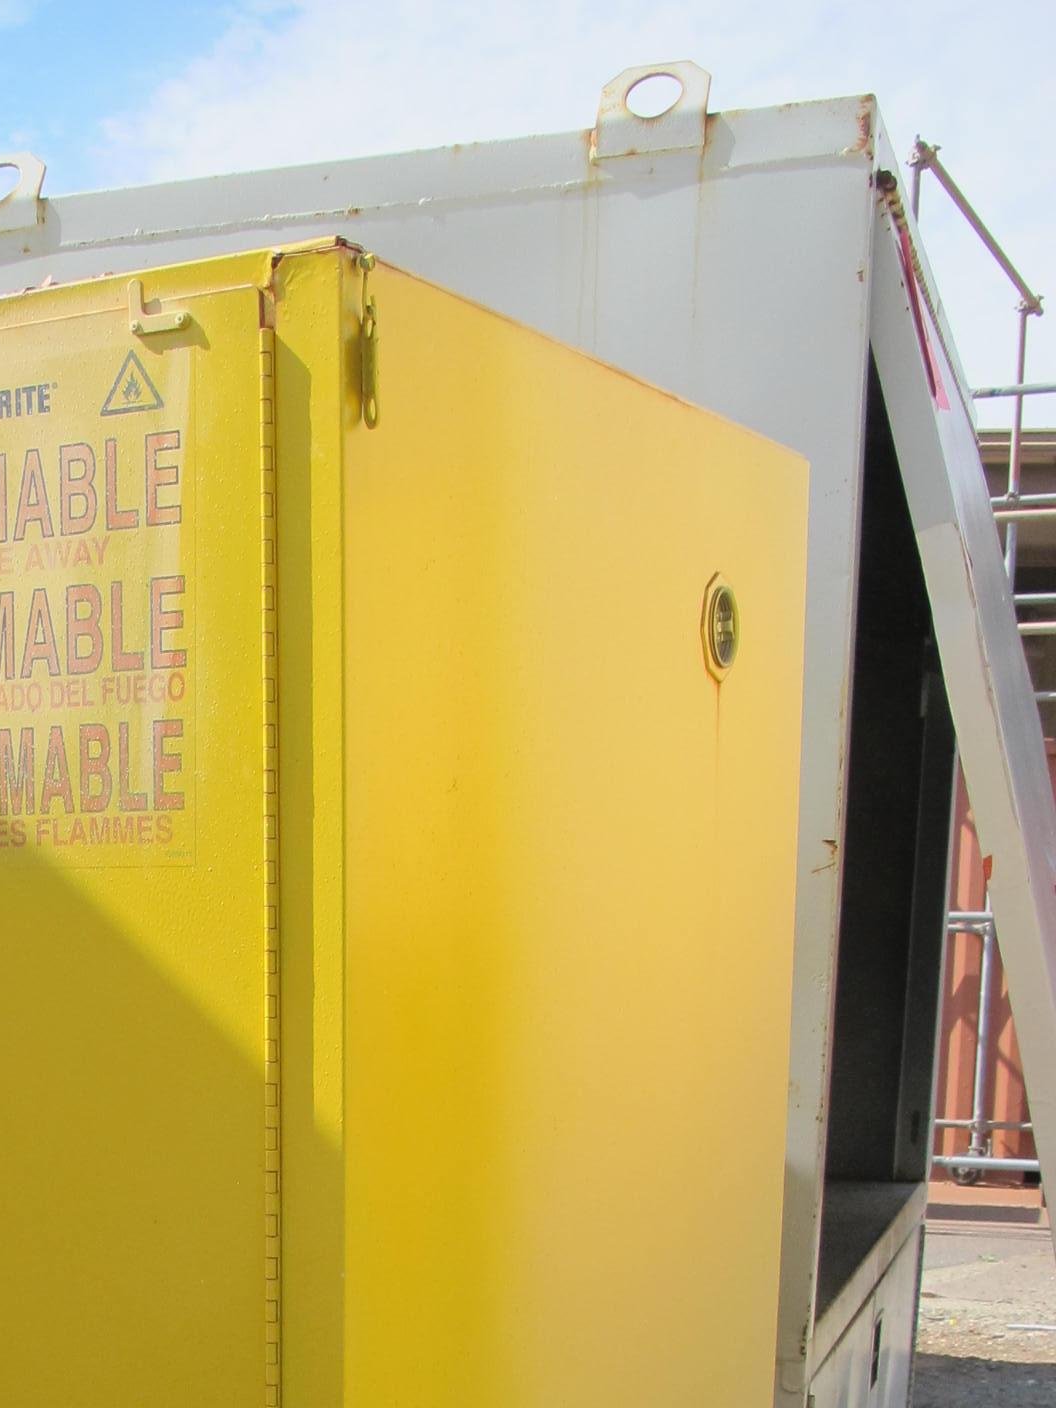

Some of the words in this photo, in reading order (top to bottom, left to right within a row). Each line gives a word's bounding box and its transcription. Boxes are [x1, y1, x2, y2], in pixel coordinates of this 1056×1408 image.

[25, 536, 110, 571] AWAY
[50, 678, 95, 710] DEL
[102, 671, 186, 705] FUEGO
[36, 814, 173, 847] FLAMMES
